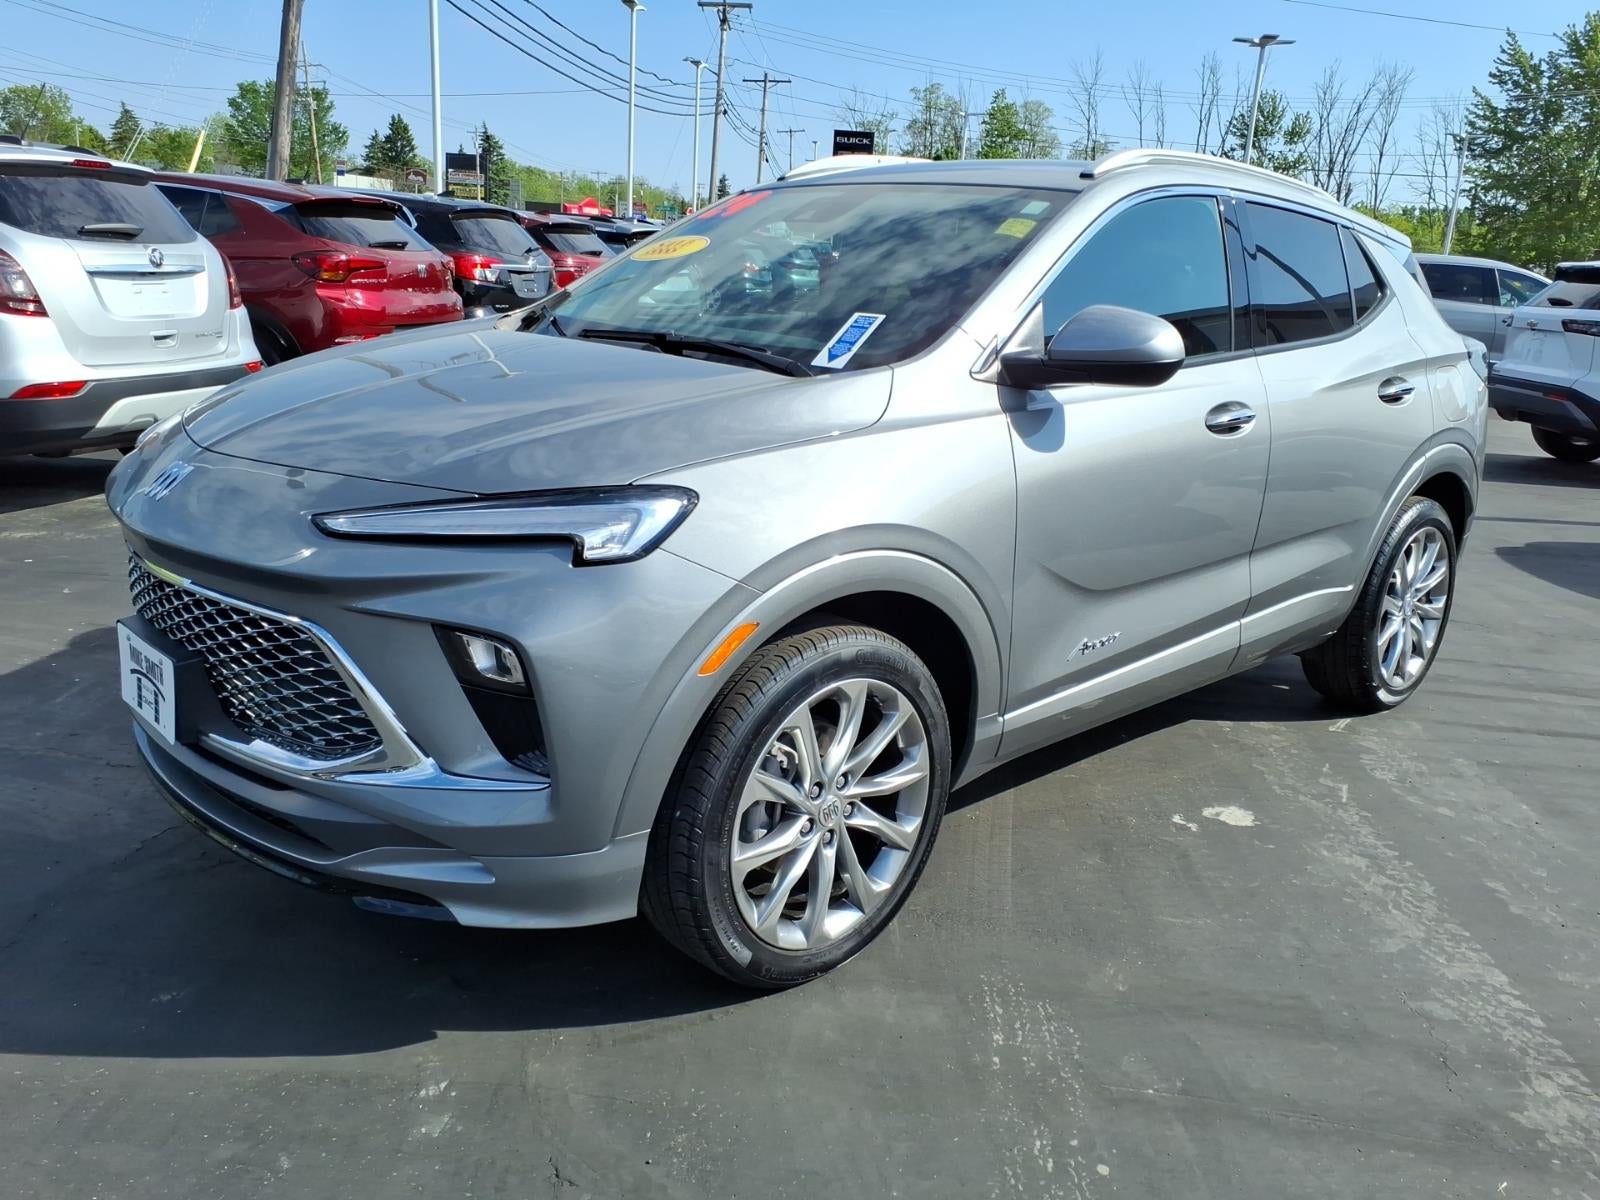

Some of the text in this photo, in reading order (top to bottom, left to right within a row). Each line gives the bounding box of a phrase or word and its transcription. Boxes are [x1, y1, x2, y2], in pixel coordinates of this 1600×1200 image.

[836, 136, 872, 145] BUICK
[129, 642, 164, 687] MIKE SMITH
